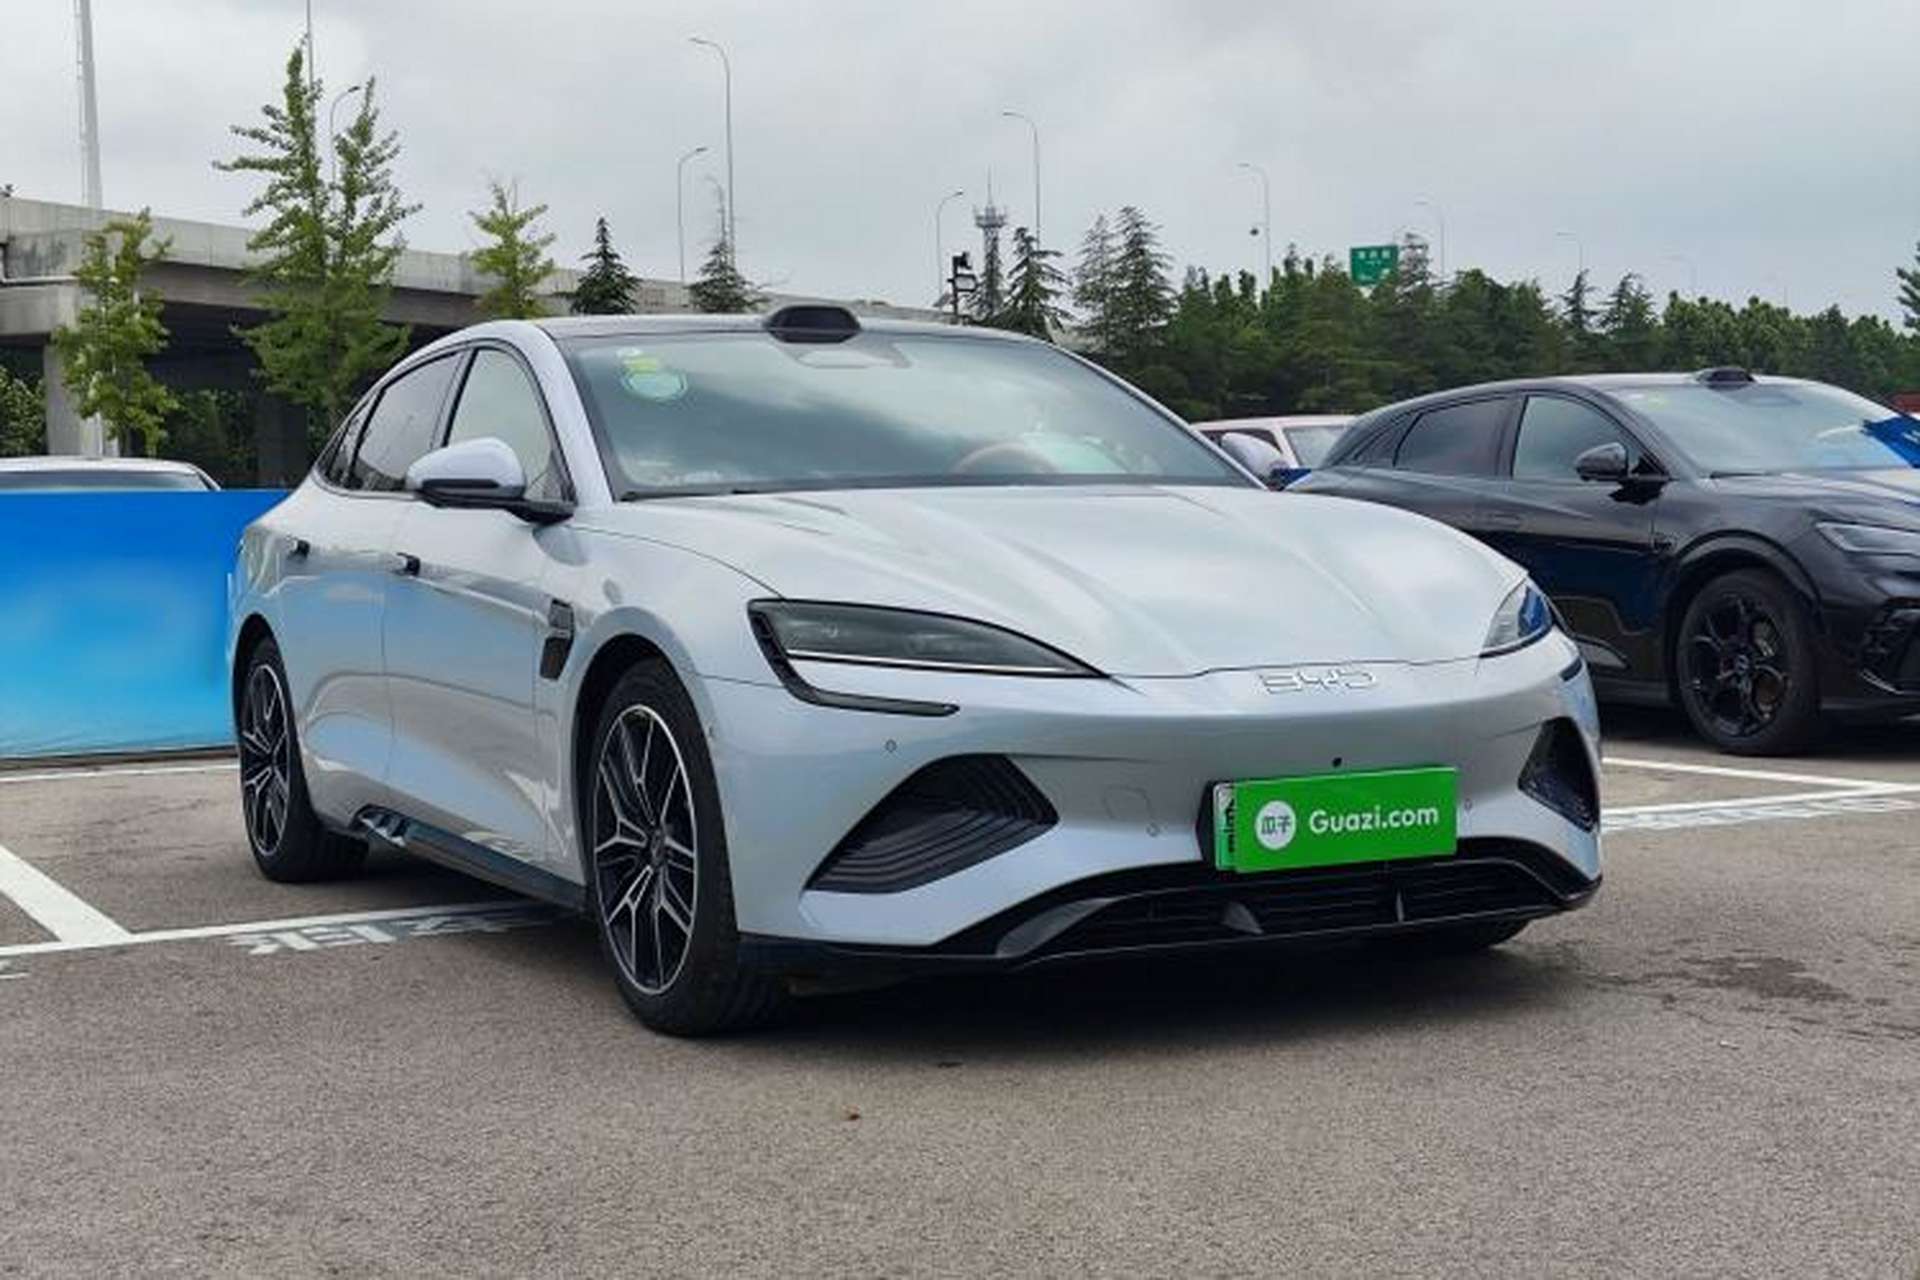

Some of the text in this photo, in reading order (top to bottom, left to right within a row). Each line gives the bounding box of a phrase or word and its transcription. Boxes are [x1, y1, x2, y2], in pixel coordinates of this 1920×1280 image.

[1259, 669, 1377, 695] BYD
[1261, 815, 1291, 834] 瓜子
[1309, 804, 1438, 834] Guazi.com
